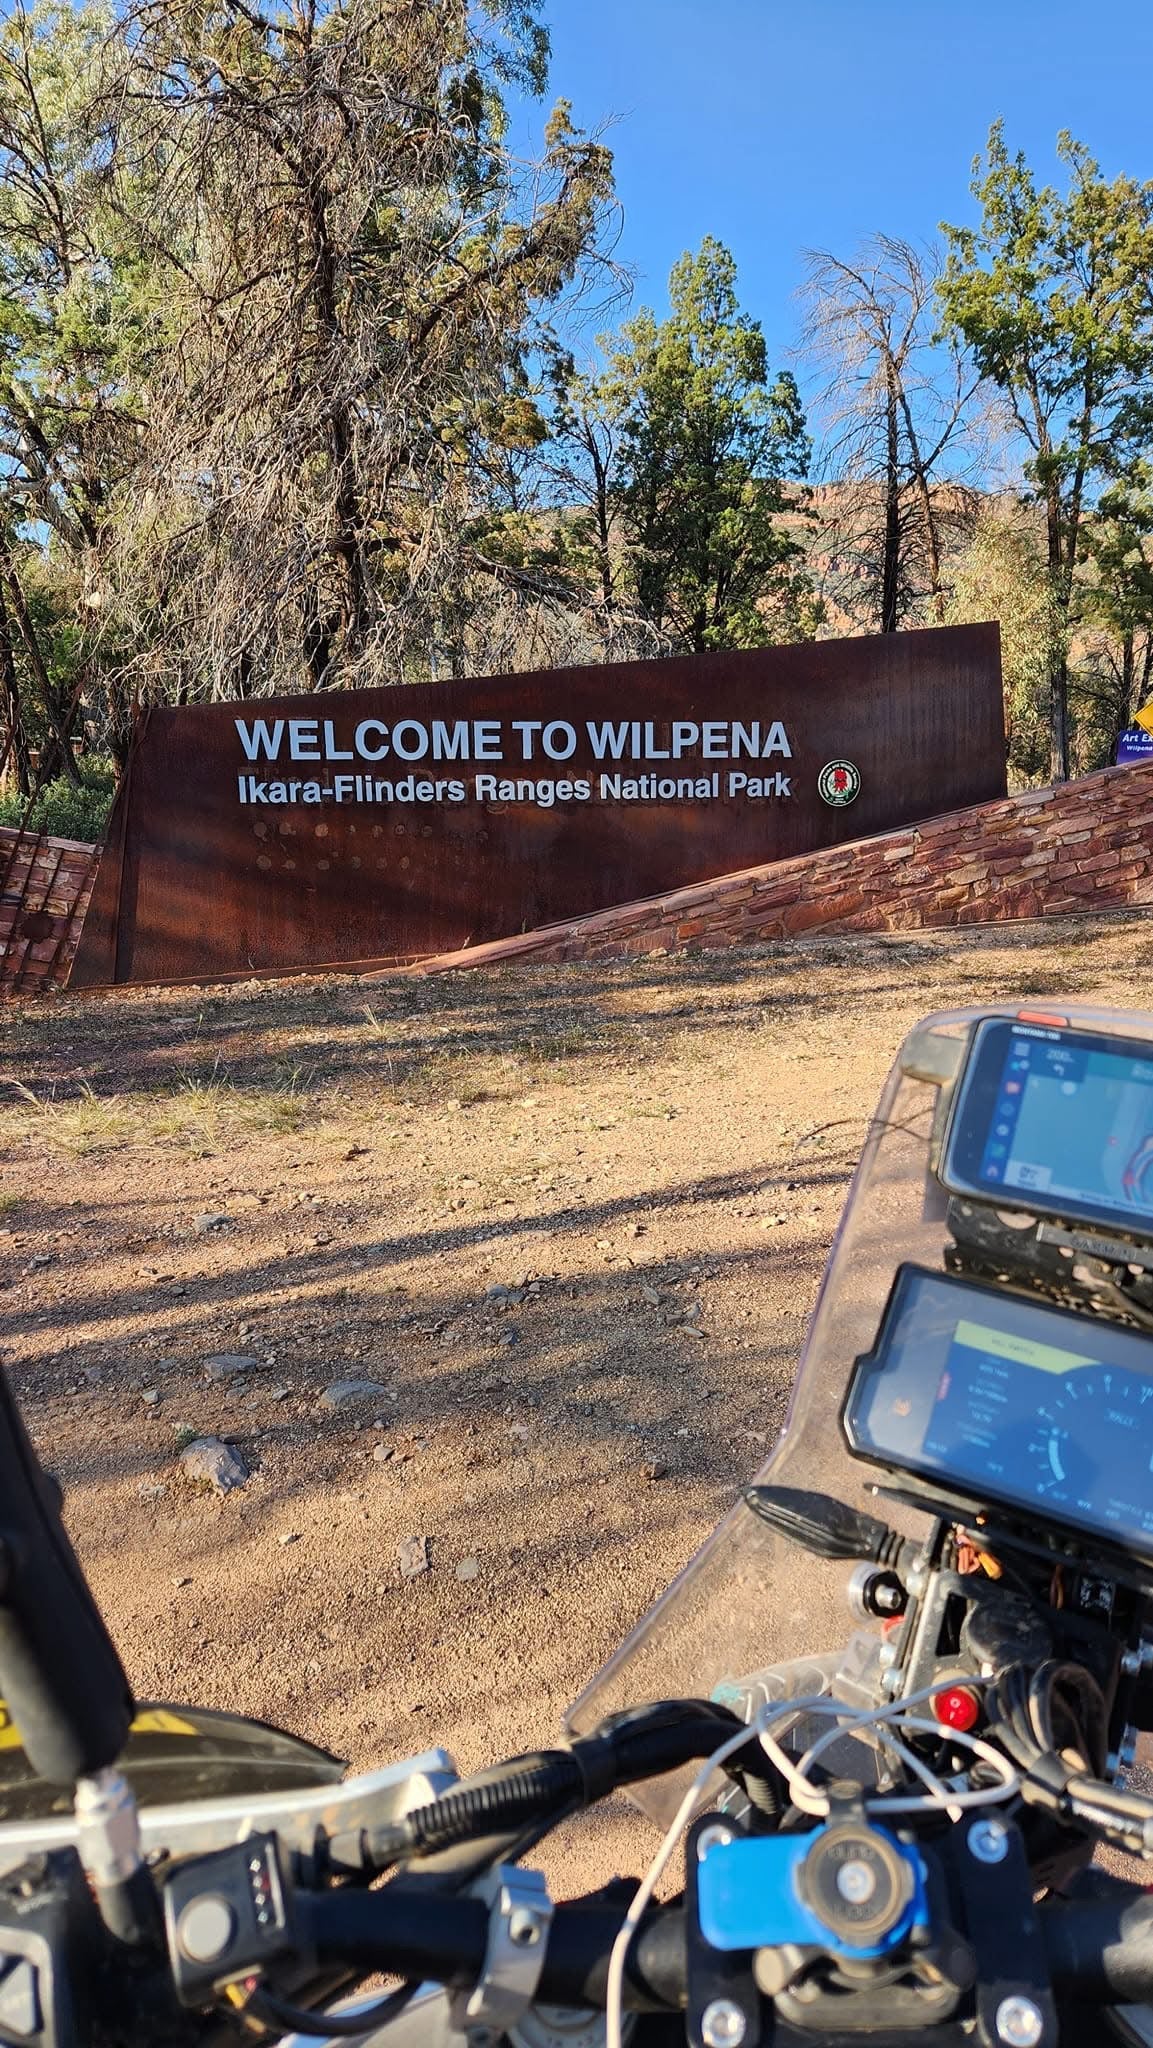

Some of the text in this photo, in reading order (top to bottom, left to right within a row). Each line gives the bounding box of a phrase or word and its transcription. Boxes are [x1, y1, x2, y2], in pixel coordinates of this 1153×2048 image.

[235, 719, 793, 761] WELCOME TO WILPENA
[1122, 733, 1139, 742] Art
[238, 774, 466, 804] Ikara-Flinders
[475, 774, 591, 808] Ranges
[600, 772, 719, 801] National
[729, 771, 791, 798] Park
